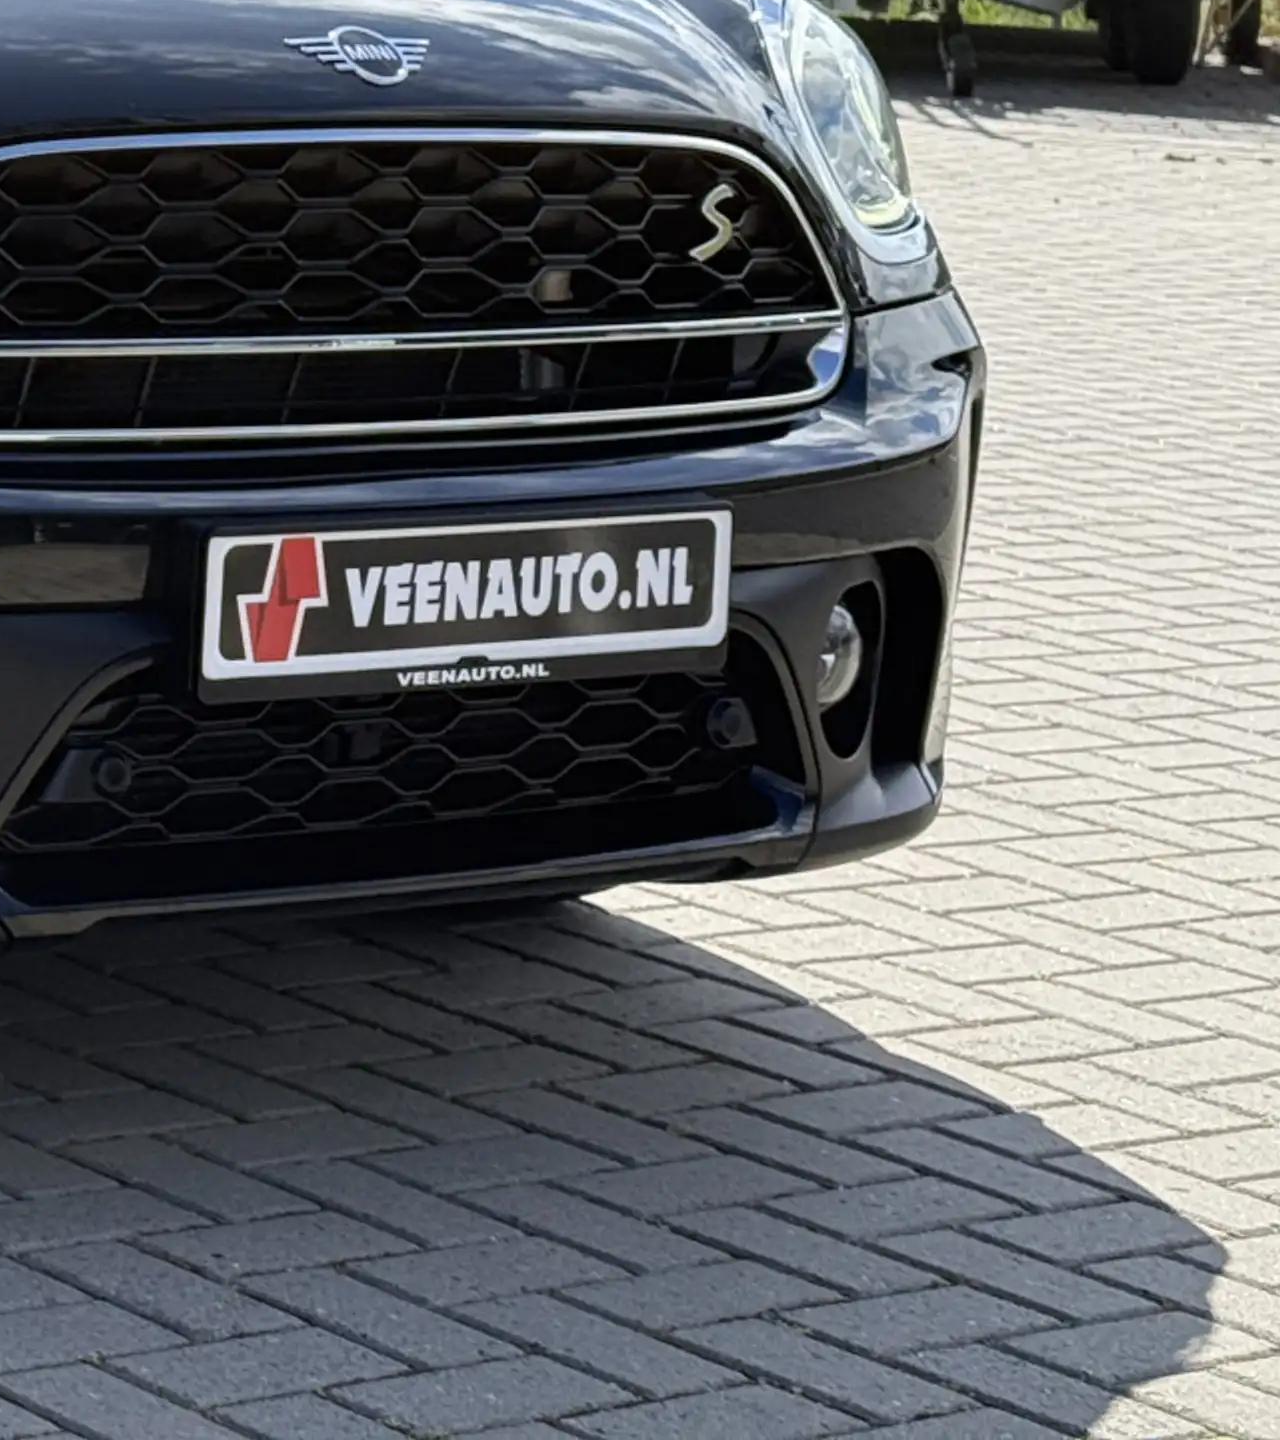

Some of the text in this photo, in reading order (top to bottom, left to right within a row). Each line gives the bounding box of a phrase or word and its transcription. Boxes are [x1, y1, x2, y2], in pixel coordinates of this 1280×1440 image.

[343, 44, 397, 61] MINI
[689, 182, 736, 262] S
[345, 546, 694, 628] VEENAUTO.NL
[396, 663, 550, 687] VEENAUTO.NL
